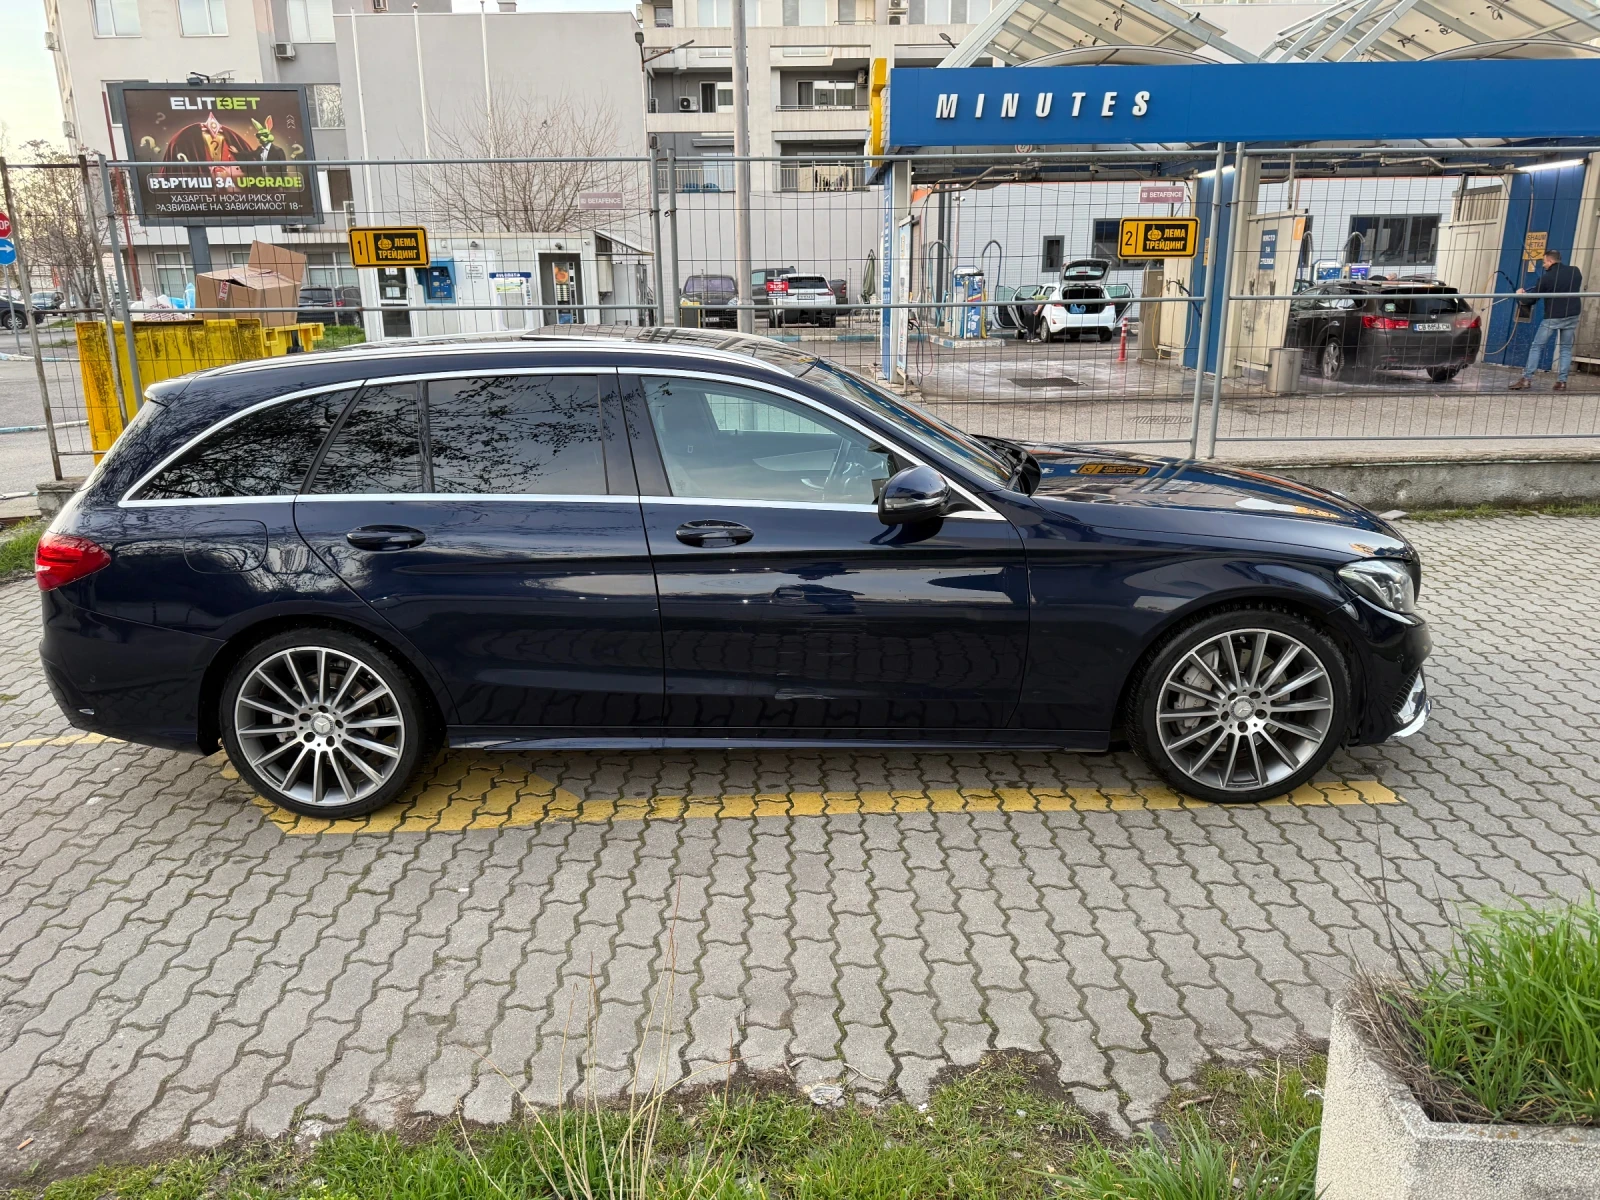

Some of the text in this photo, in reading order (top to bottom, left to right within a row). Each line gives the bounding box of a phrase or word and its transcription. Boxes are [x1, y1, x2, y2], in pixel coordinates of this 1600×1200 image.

[935, 90, 1150, 119] MINUTES
[150, 176, 303, 189] ВЪРТИШ ЗА UPGRADE
[170, 195, 216, 203] ХАЗАРТЪТ
[219, 194, 246, 202] НОСИ
[248, 194, 273, 202] РИСК
[156, 203, 208, 212] РАЗВИВАНЕ
[210, 203, 223, 211] НА
[225, 202, 287, 211] ЗАВИСИМОСТ
[1125, 230, 1133, 246] 2
[1163, 228, 1186, 238] ЛЕМА
[394, 238, 417, 247] ЛЕМА
[1146, 239, 1185, 250] ТРЕЙДИНГ
[378, 248, 417, 259] ТРЕЙДИНГ
